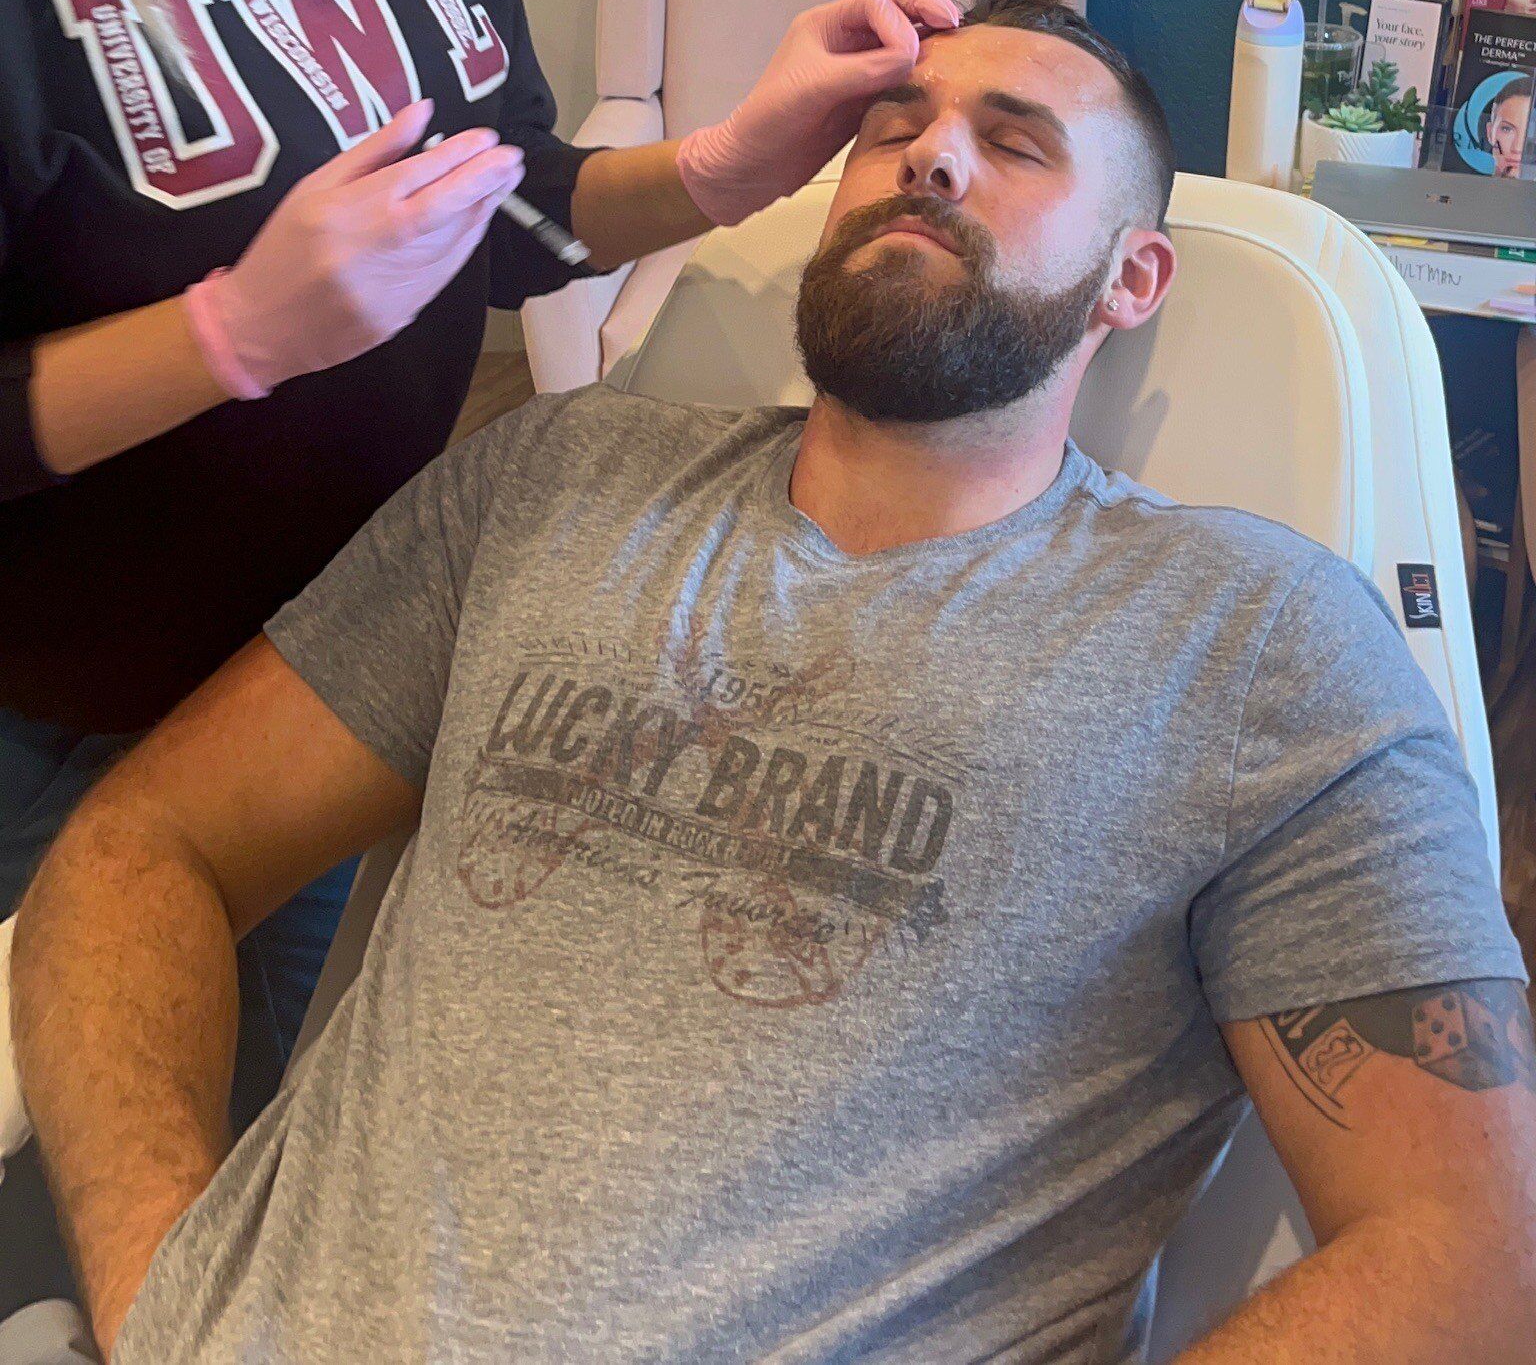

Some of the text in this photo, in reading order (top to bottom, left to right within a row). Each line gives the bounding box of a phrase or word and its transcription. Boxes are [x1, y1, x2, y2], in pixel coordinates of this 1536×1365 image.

[1376, 17, 1399, 32] Your
[1373, 34, 1426, 51] your story
[1473, 32, 1494, 46] THE
[90, 3, 177, 175] UNIVERSITY OF
[486, 671, 953, 874] LUCKY BRAND
